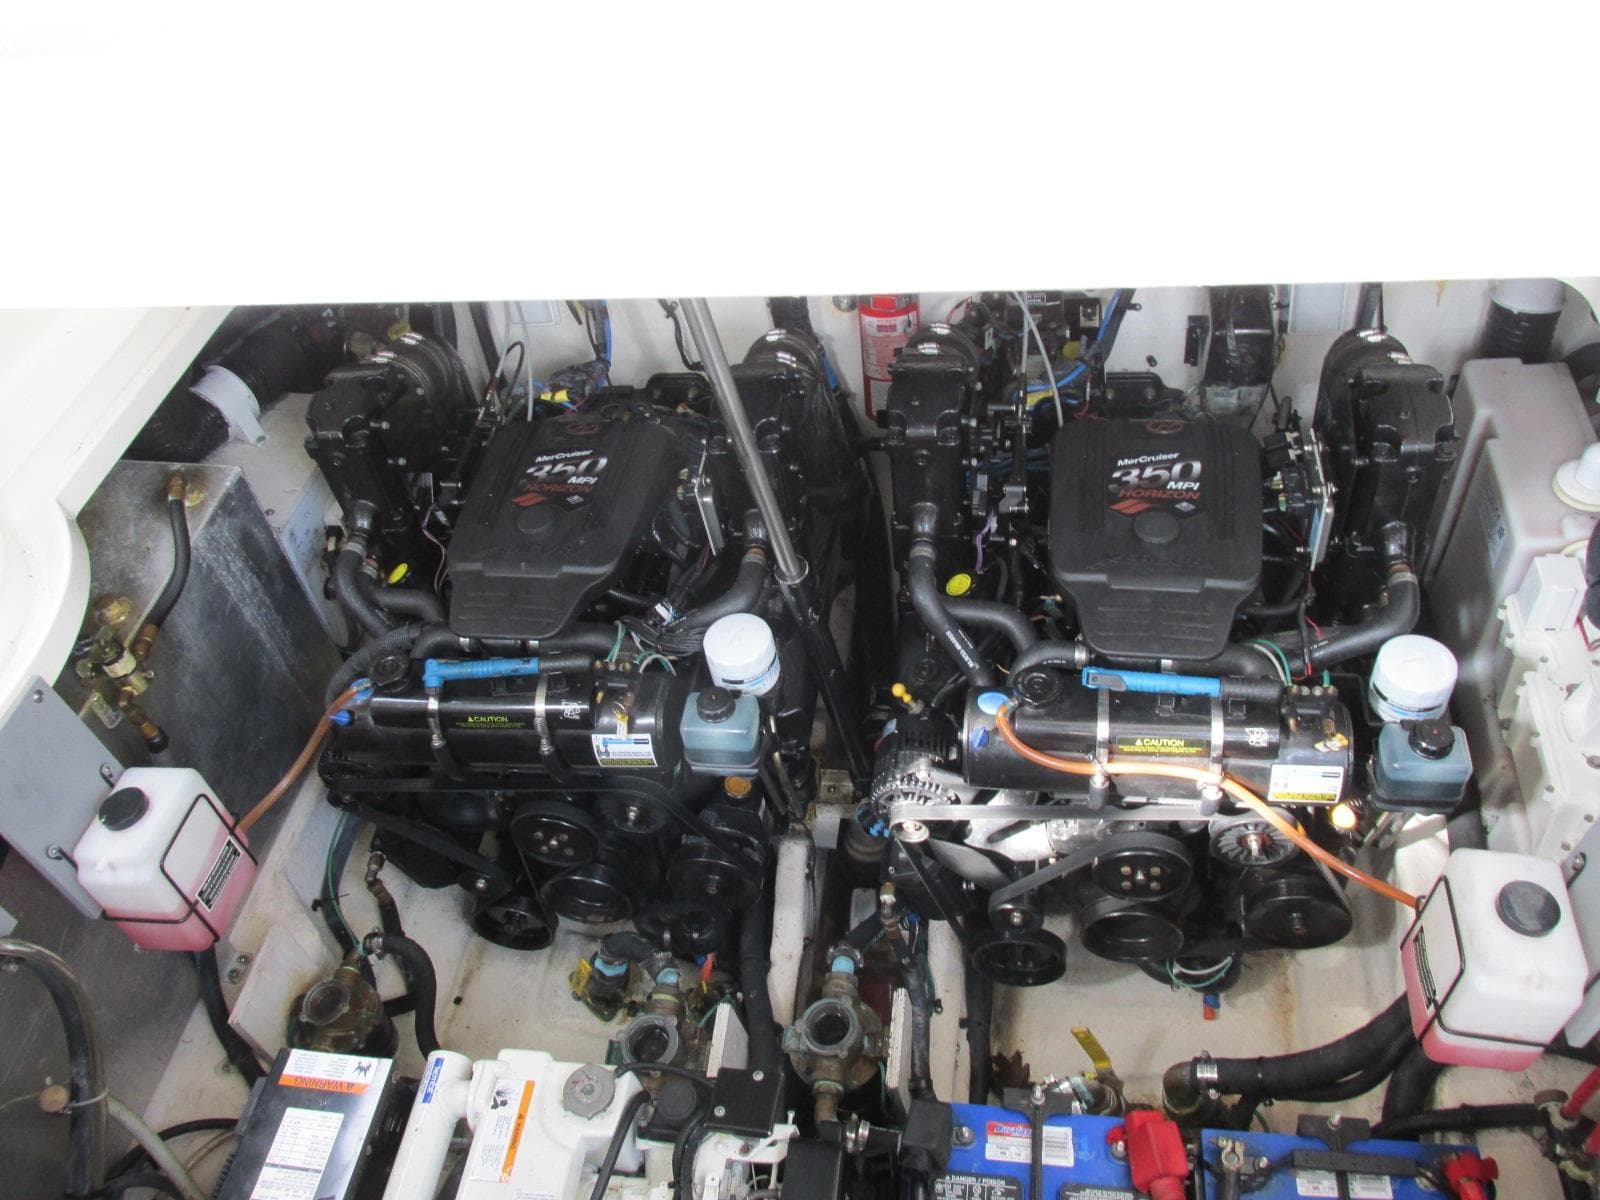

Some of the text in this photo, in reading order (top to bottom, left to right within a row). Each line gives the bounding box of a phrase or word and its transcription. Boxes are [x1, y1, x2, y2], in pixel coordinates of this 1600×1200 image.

[535, 450, 593, 463] MerCruiser
[1117, 452, 1180, 467] MerCruiser
[520, 458, 608, 484] 350
[1108, 461, 1202, 493] 350
[567, 476, 598, 484] MPI
[1166, 481, 1200, 490] MPI
[1118, 489, 1201, 499] HORIZON
[1143, 738, 1186, 748] CAUTION
[294, 1076, 343, 1091] WARNING
[951, 1175, 977, 1184] DANGER
[982, 1178, 1006, 1187] POISON
